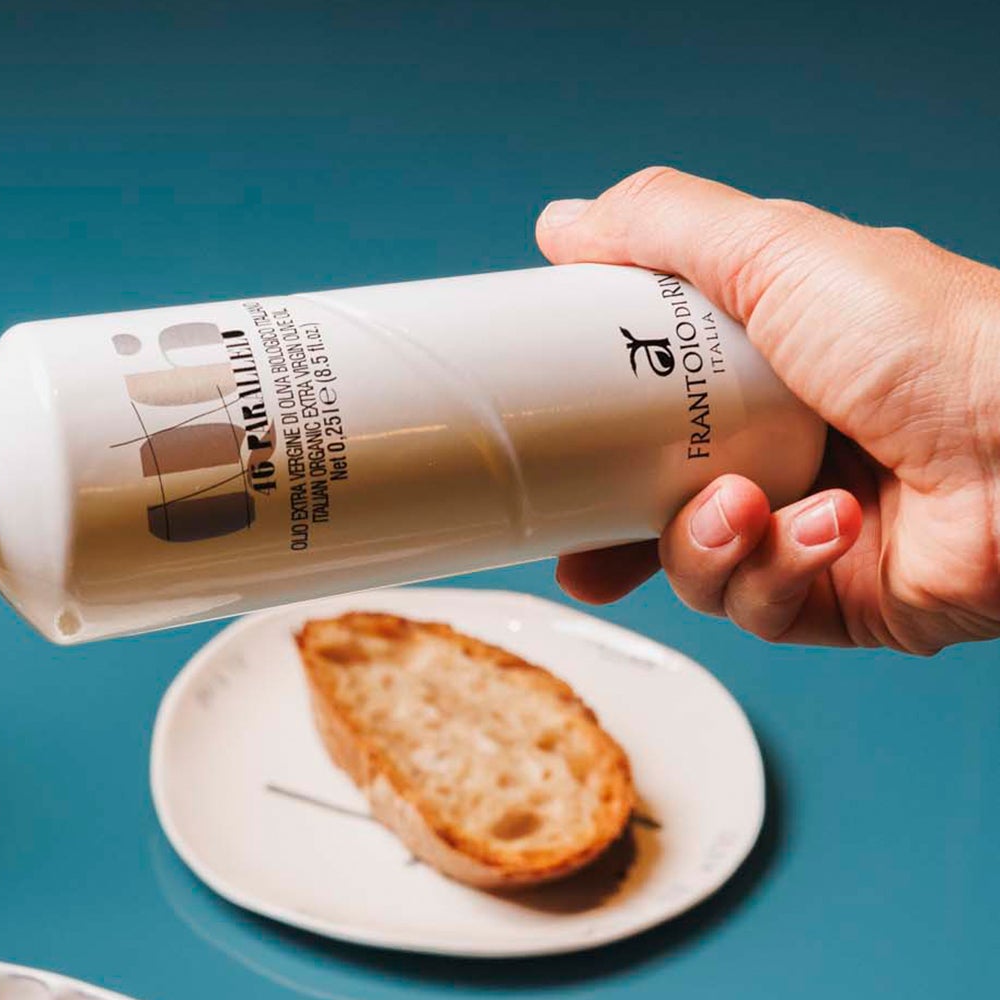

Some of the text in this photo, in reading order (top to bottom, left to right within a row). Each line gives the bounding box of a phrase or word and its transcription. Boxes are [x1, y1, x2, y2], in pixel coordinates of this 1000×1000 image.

[257, 327, 288, 374] BIOLOGICO
[701, 311, 726, 374] ITALIA
[652, 272, 711, 460] FRANTOIO DI RIV
[274, 375, 296, 409] OLIVA
[271, 307, 330, 524] ITALIAN ORGANIC EXTRA VIRGIN OLIVE OIL
[280, 411, 299, 425] DI
[283, 426, 306, 481] VERGINE
[328, 456, 348, 481] Net
[248, 460, 278, 497] 46
[290, 482, 309, 521] EXTRA
[290, 523, 309, 552] OLIO
